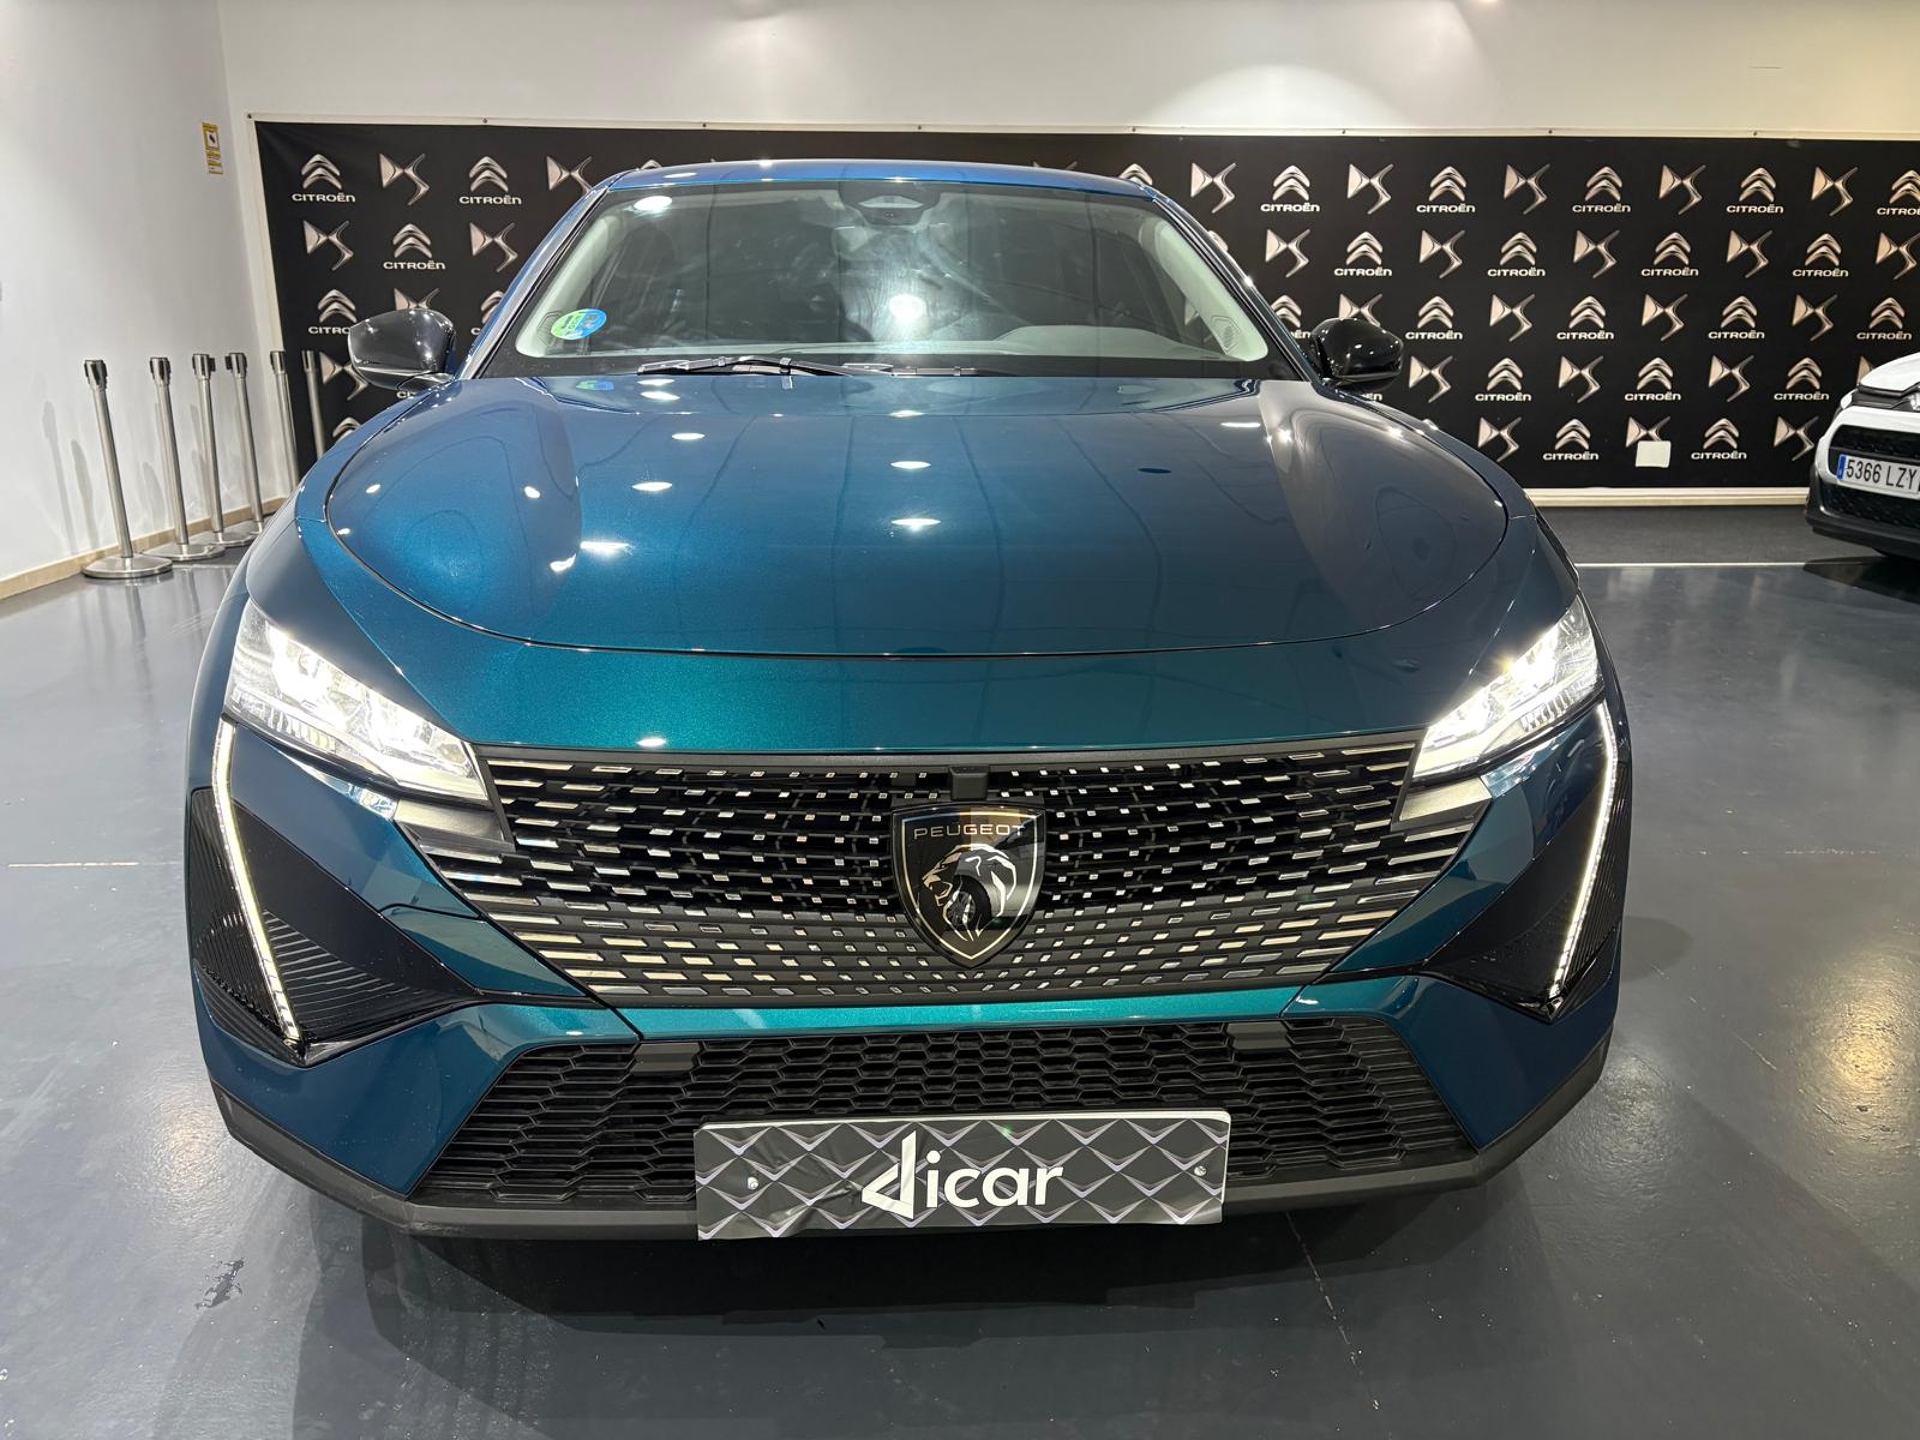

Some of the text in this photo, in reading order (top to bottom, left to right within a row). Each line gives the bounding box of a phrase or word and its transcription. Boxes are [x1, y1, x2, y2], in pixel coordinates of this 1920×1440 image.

[1876, 207, 1920, 216] CITRO
[308, 325, 350, 335] CITRO
[1846, 460, 1881, 483] 5366
[1886, 465, 1917, 489] LZY
[914, 824, 1024, 839] PEUGEOT
